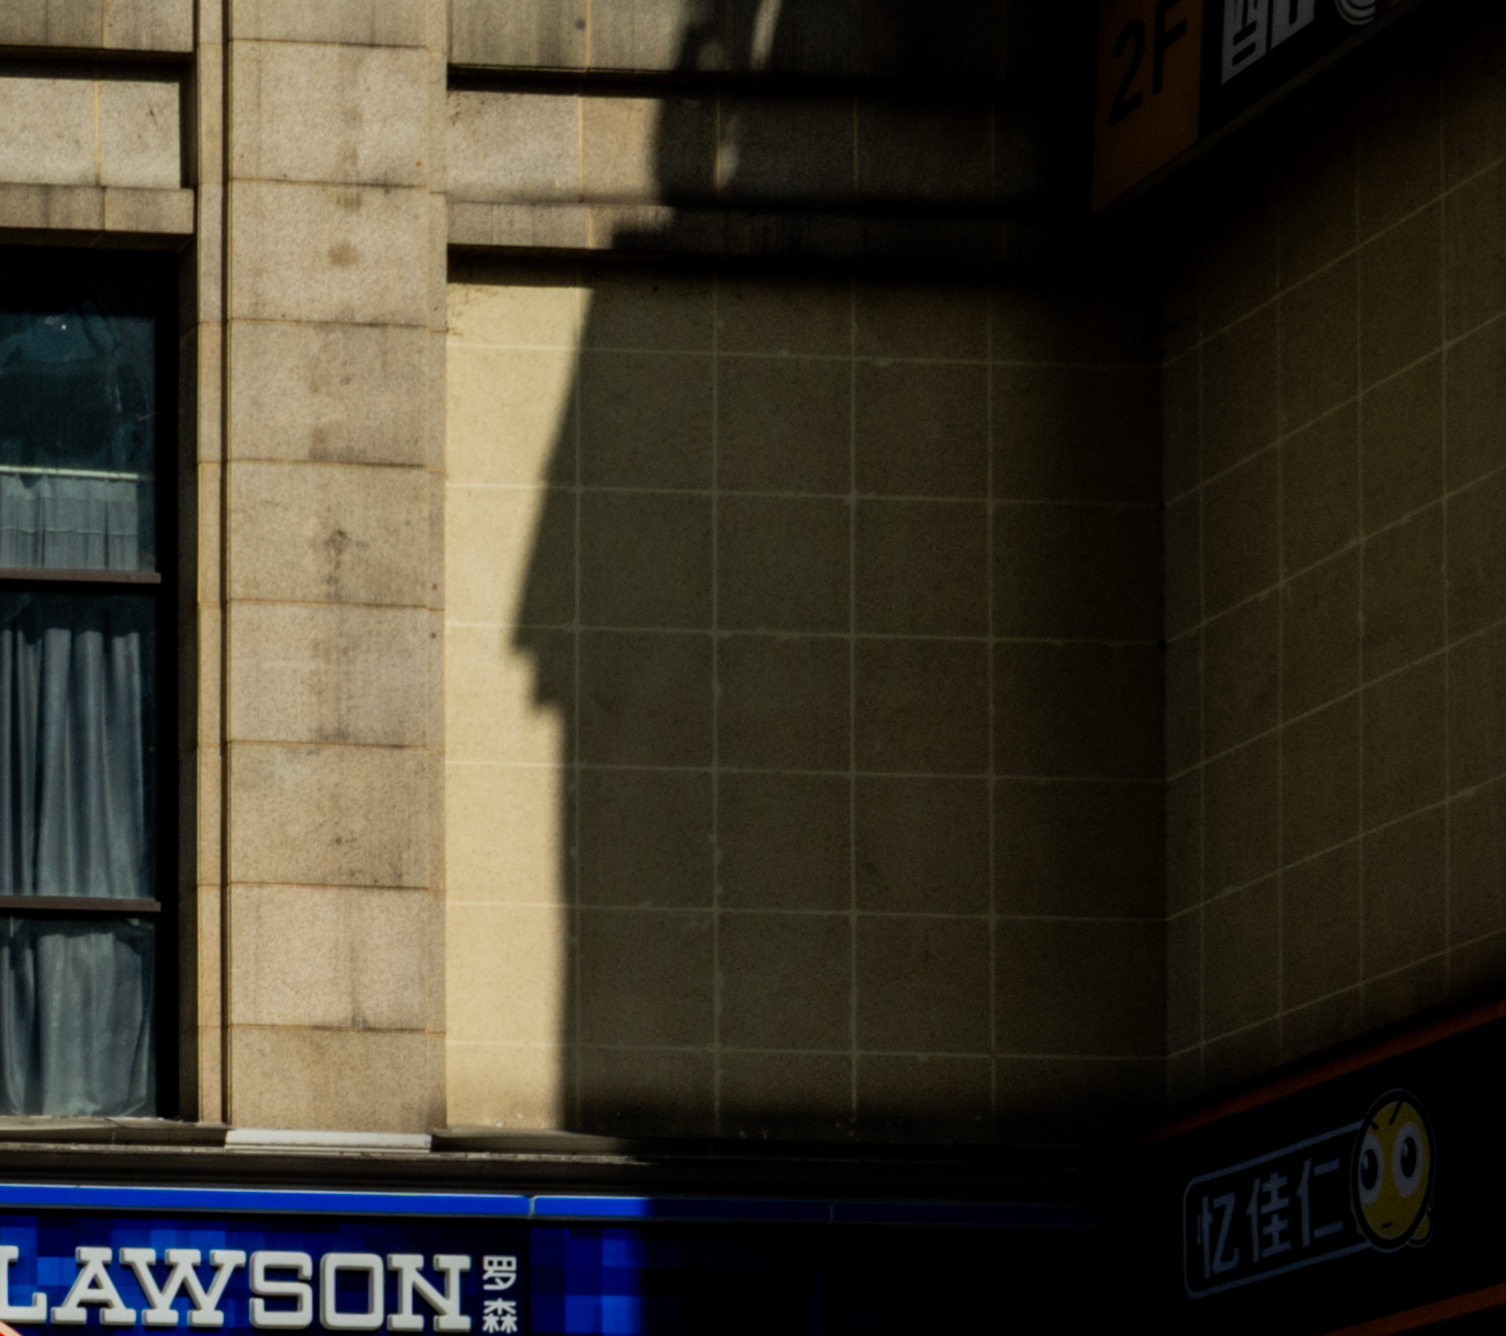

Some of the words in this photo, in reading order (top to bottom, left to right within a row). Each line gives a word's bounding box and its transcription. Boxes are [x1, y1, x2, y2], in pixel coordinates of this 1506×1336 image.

[1197, 1158, 1345, 1280] 忆佳仁
[481, 1255, 518, 1334] 罗森
